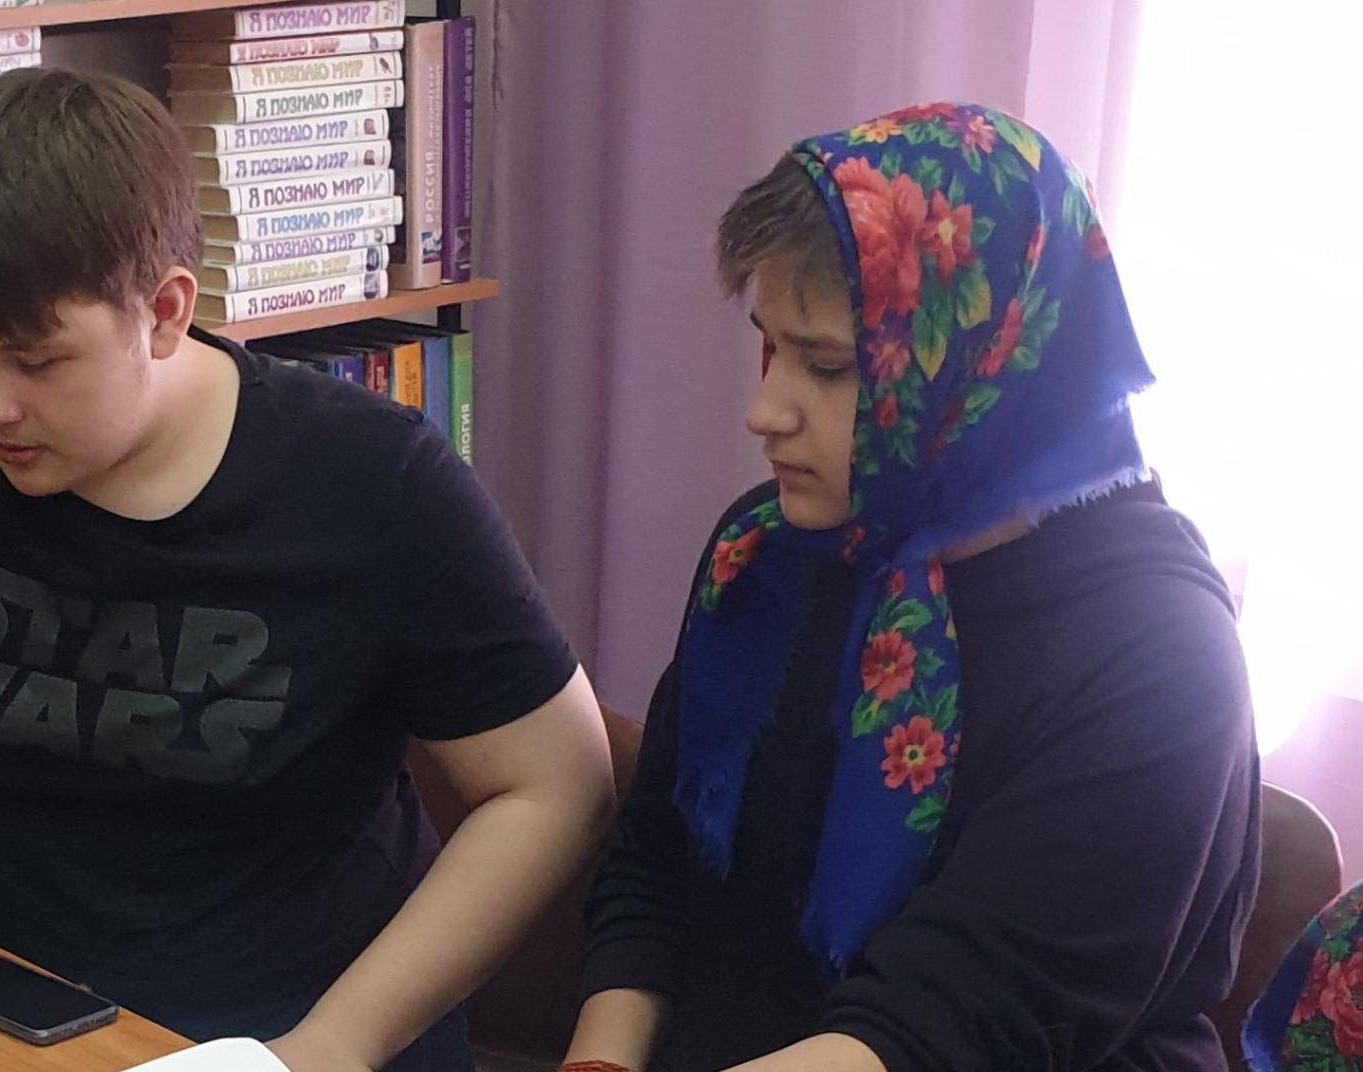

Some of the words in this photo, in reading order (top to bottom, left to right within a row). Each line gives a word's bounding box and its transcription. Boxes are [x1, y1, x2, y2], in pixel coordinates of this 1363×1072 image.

[250, 12, 262, 32] Я
[267, 8, 332, 31] ПОЗНАЮ
[337, 5, 371, 26] МИР
[252, 67, 264, 87] Я
[268, 63, 330, 84] ПОЗНАЮ
[332, 59, 364, 79] МИР
[256, 98, 267, 118] Я
[271, 93, 329, 116] ПОЗНАЮ
[333, 88, 364, 110] МИР
[235, 129, 246, 148] Я
[250, 124, 313, 147] ПОЗНАЮ
[316, 120, 348, 140] МИР
[236, 160, 247, 178] Я
[251, 155, 313, 177] ПОЗНАЮ
[316, 151, 349, 171] МИР
[249, 188, 261, 208] Я
[264, 182, 328, 206] ПОЗНАЮ
[332, 176, 365, 197] МИР
[257, 217, 268, 236] Я
[271, 211, 331, 234] ПОЗНАЮ
[334, 206, 365, 225] МИР
[251, 244, 263, 261] Я
[266, 237, 323, 259] ПОЗНАЮ
[326, 232, 356, 251] МИР
[248, 267, 259, 287] Я
[262, 261, 320, 285] ПОЗНАЮ
[321, 255, 351, 276] МИР
[248, 297, 258, 315] Я
[261, 289, 315, 312] ПОЗНАЮ
[318, 284, 346, 303] МИР
